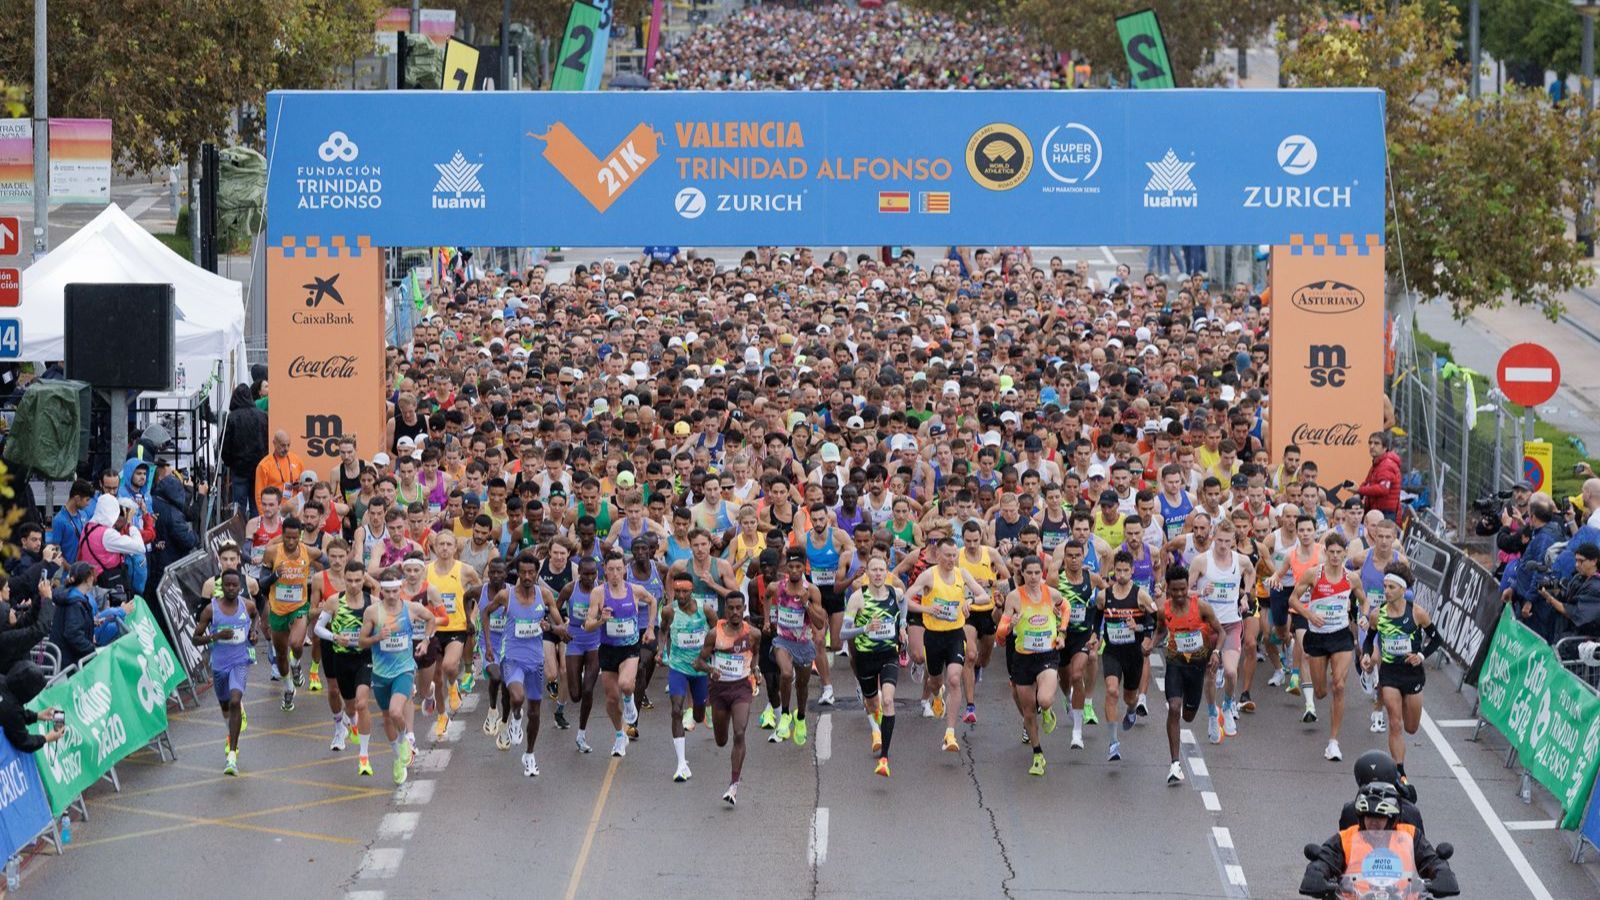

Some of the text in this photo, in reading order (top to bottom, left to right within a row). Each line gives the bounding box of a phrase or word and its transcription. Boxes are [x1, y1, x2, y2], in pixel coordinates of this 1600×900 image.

[562, 24, 594, 73] 2
[675, 121, 805, 149] VALENCIA
[1052, 143, 1092, 154] SUPER
[1052, 154, 1092, 164] HALFS
[297, 164, 382, 176] FUNDACIÓN
[597, 138, 647, 198] 21K
[675, 157, 952, 181] TRINIDAD ALFONSO
[297, 179, 382, 193] TRINIDAD
[297, 195, 382, 209] ALFONSO
[432, 194, 486, 209] luanvi
[717, 194, 802, 211] ZURICH
[1143, 193, 1198, 208] luanvi
[1243, 186, 1352, 208] ZURICH
[1298, 291, 1359, 306] ASTURIANA
[292, 311, 354, 325] CaixaBank
[0, 325, 17, 352] 4
[1534, 740, 1570, 783] ALFONSO
